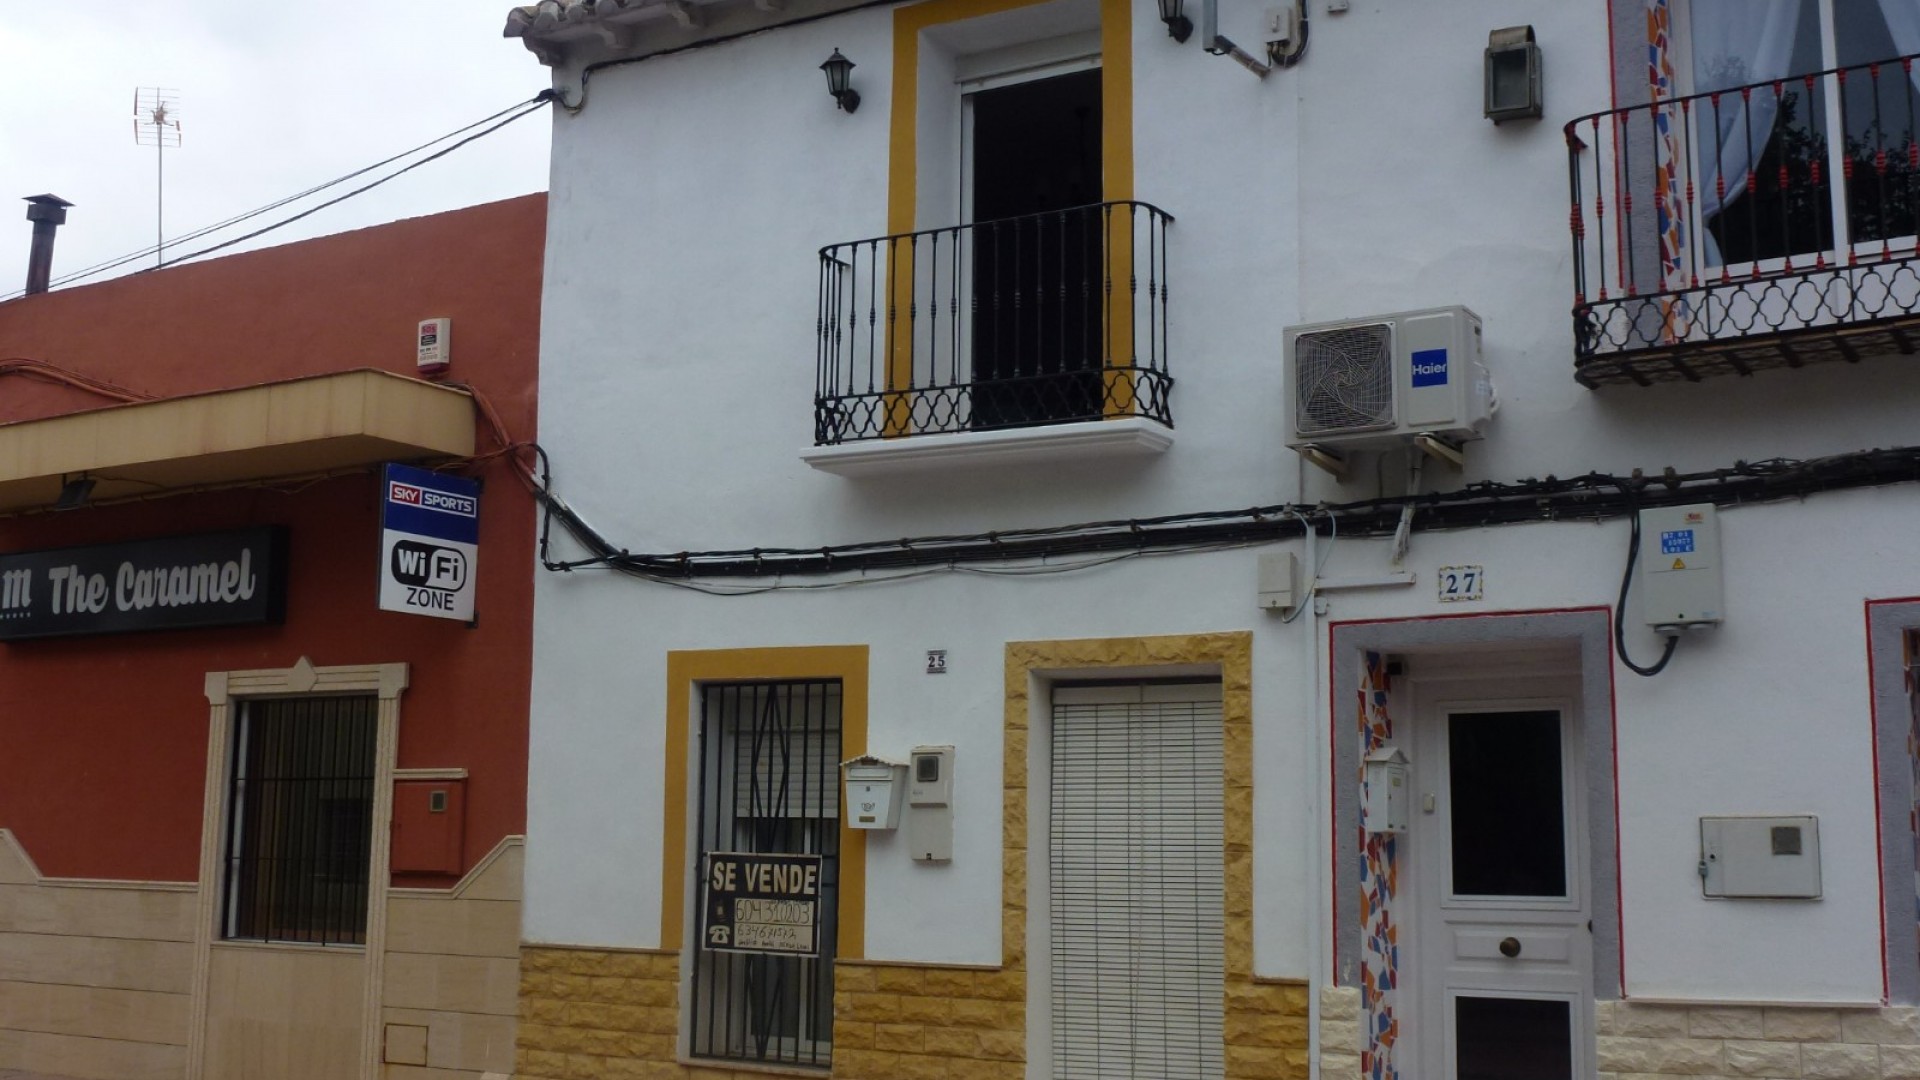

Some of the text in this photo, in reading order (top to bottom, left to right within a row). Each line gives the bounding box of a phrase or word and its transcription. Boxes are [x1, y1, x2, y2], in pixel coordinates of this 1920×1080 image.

[1413, 362, 1447, 376] Haier
[394, 486, 472, 513] SKY SPORTS
[49, 564, 109, 615] The
[115, 547, 256, 612] Caramel
[1445, 572, 1476, 594] 27
[406, 587, 455, 611] ZONE
[928, 655, 946, 668] 25
[712, 861, 817, 895] SE VENDE
